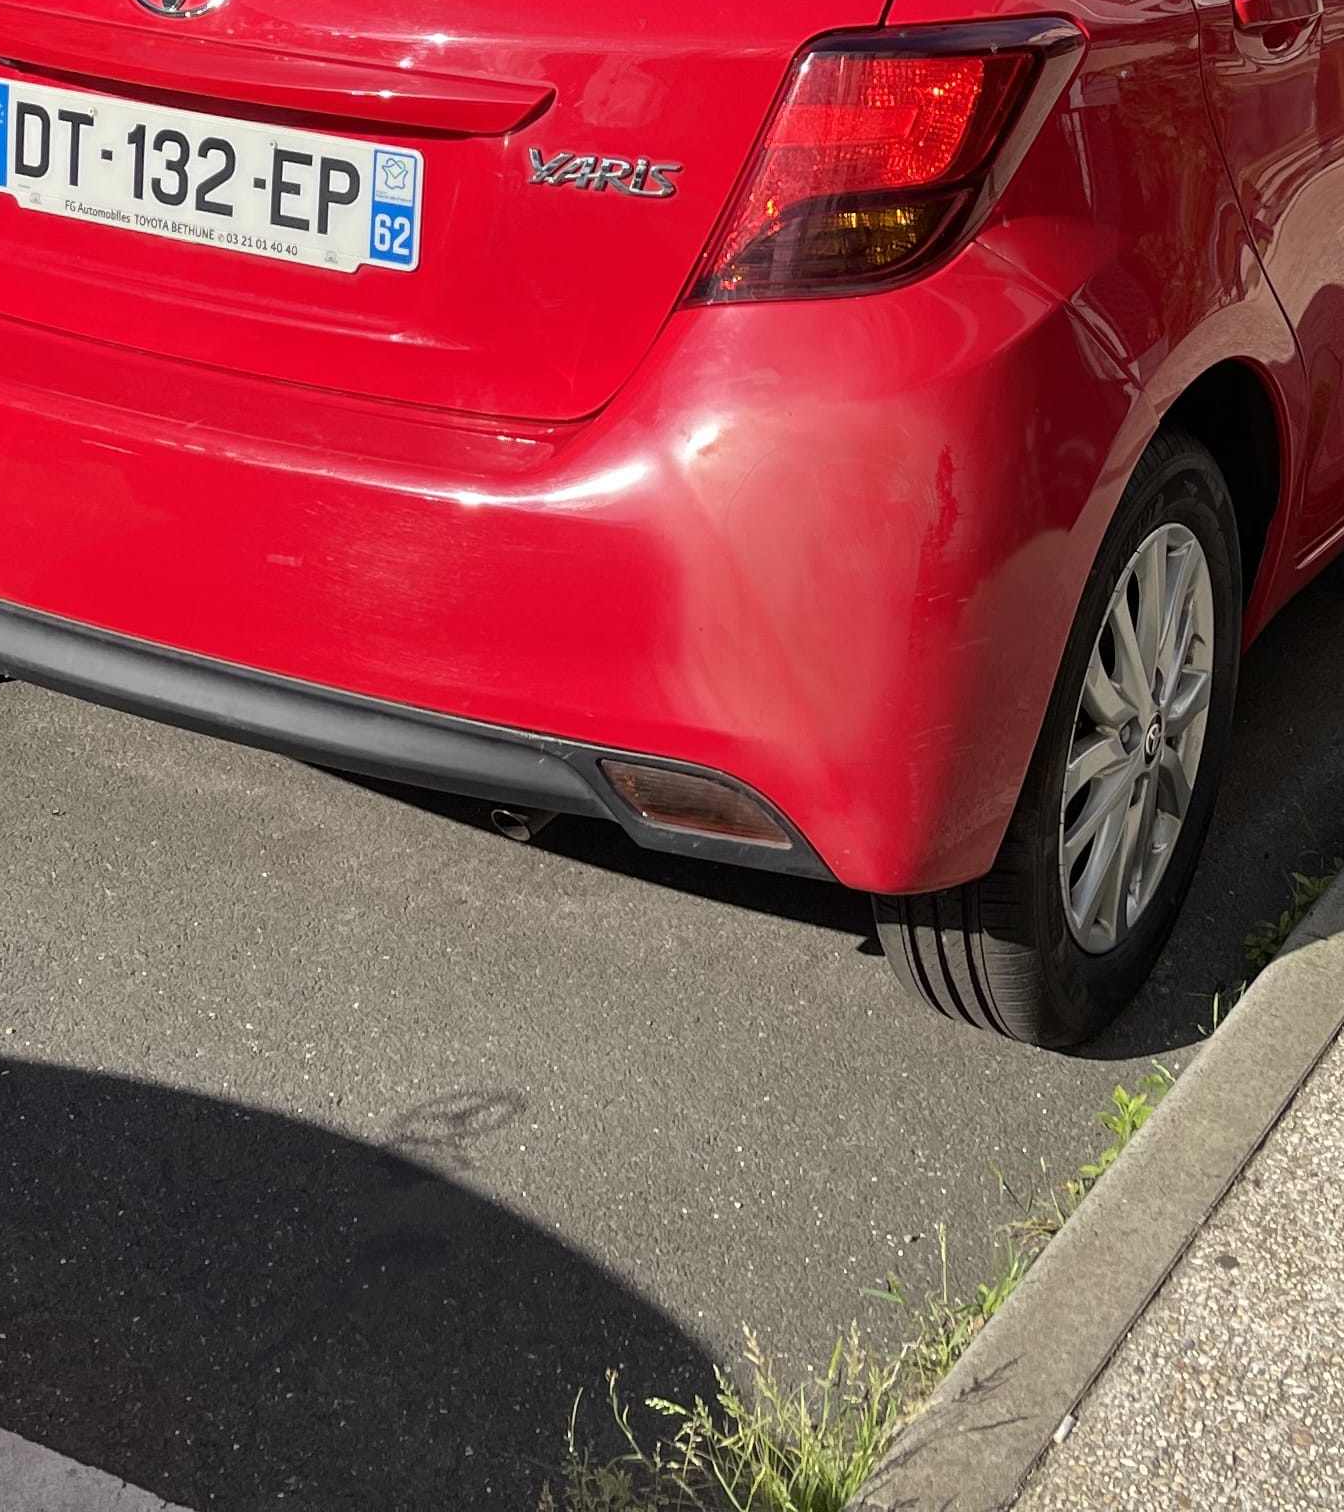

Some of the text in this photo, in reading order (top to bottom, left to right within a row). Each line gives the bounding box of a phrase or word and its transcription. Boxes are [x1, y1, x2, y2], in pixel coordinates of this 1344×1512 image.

[15, 101, 360, 235] DT-132-EP
[528, 147, 684, 199] YARIS
[64, 199, 298, 256] FG Automobiles TOYOTA BETHUNE 03 21 01 40 40
[373, 213, 411, 256] 62
